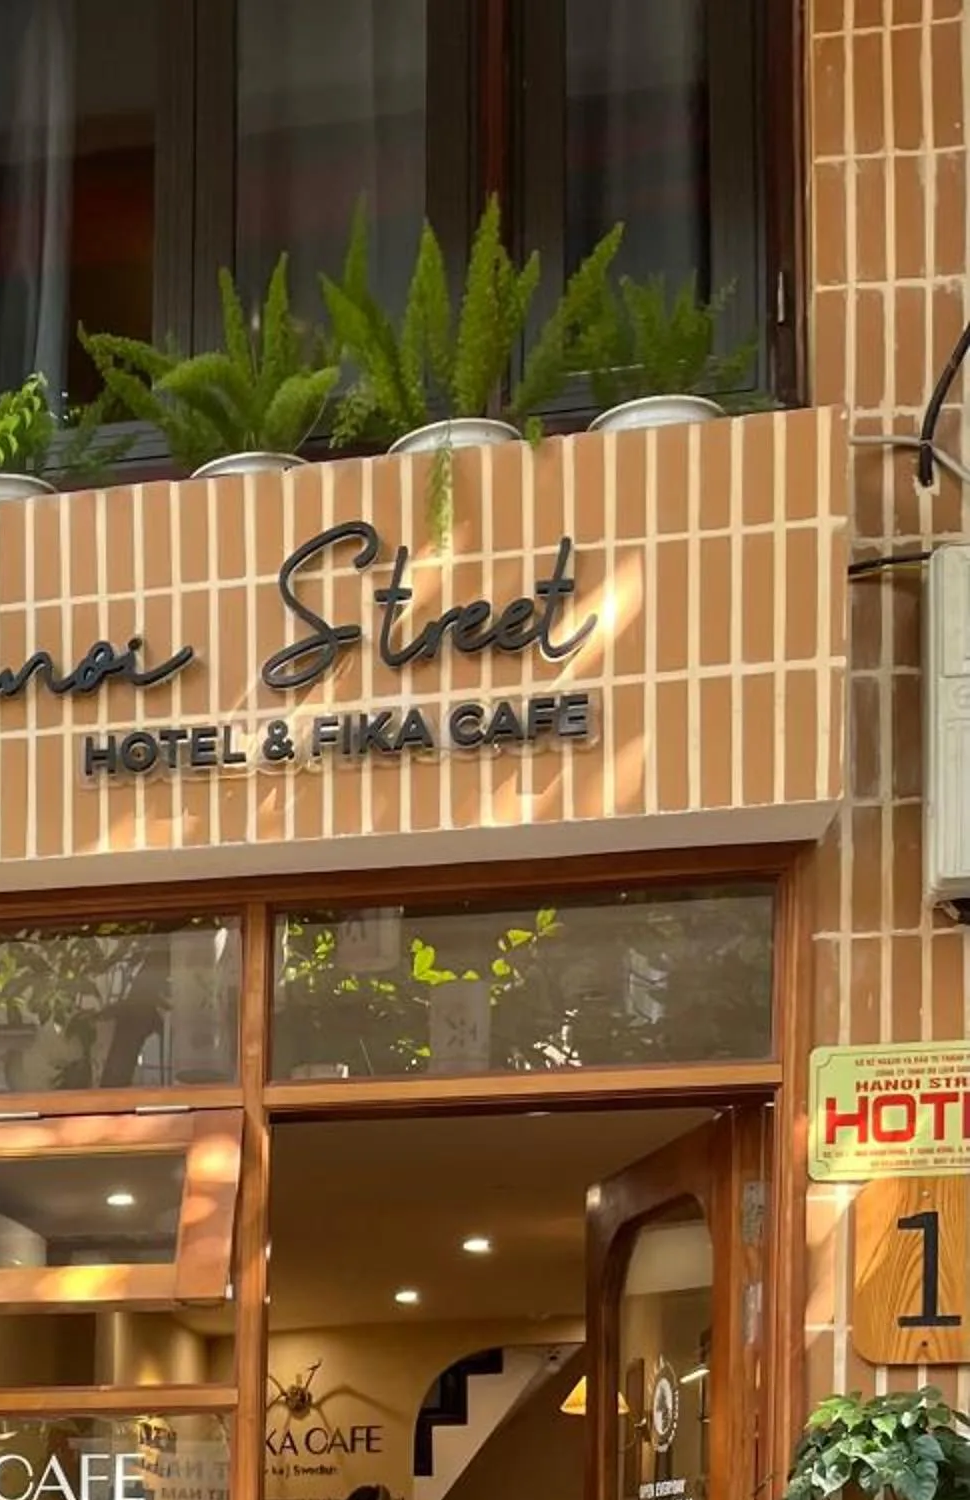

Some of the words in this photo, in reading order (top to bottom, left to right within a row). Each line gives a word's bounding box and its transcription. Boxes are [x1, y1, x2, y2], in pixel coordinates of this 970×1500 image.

[260, 520, 599, 690] Street
[84, 724, 247, 776] HOTEL
[262, 719, 296, 762] &
[312, 707, 435, 757] FIKA
[449, 694, 590, 747] CAFE
[855, 1079, 921, 1093] HANOI
[897, 1211, 962, 1328] 1
[265, 1428, 299, 1457] KA
[304, 1425, 384, 1455] CAFE
